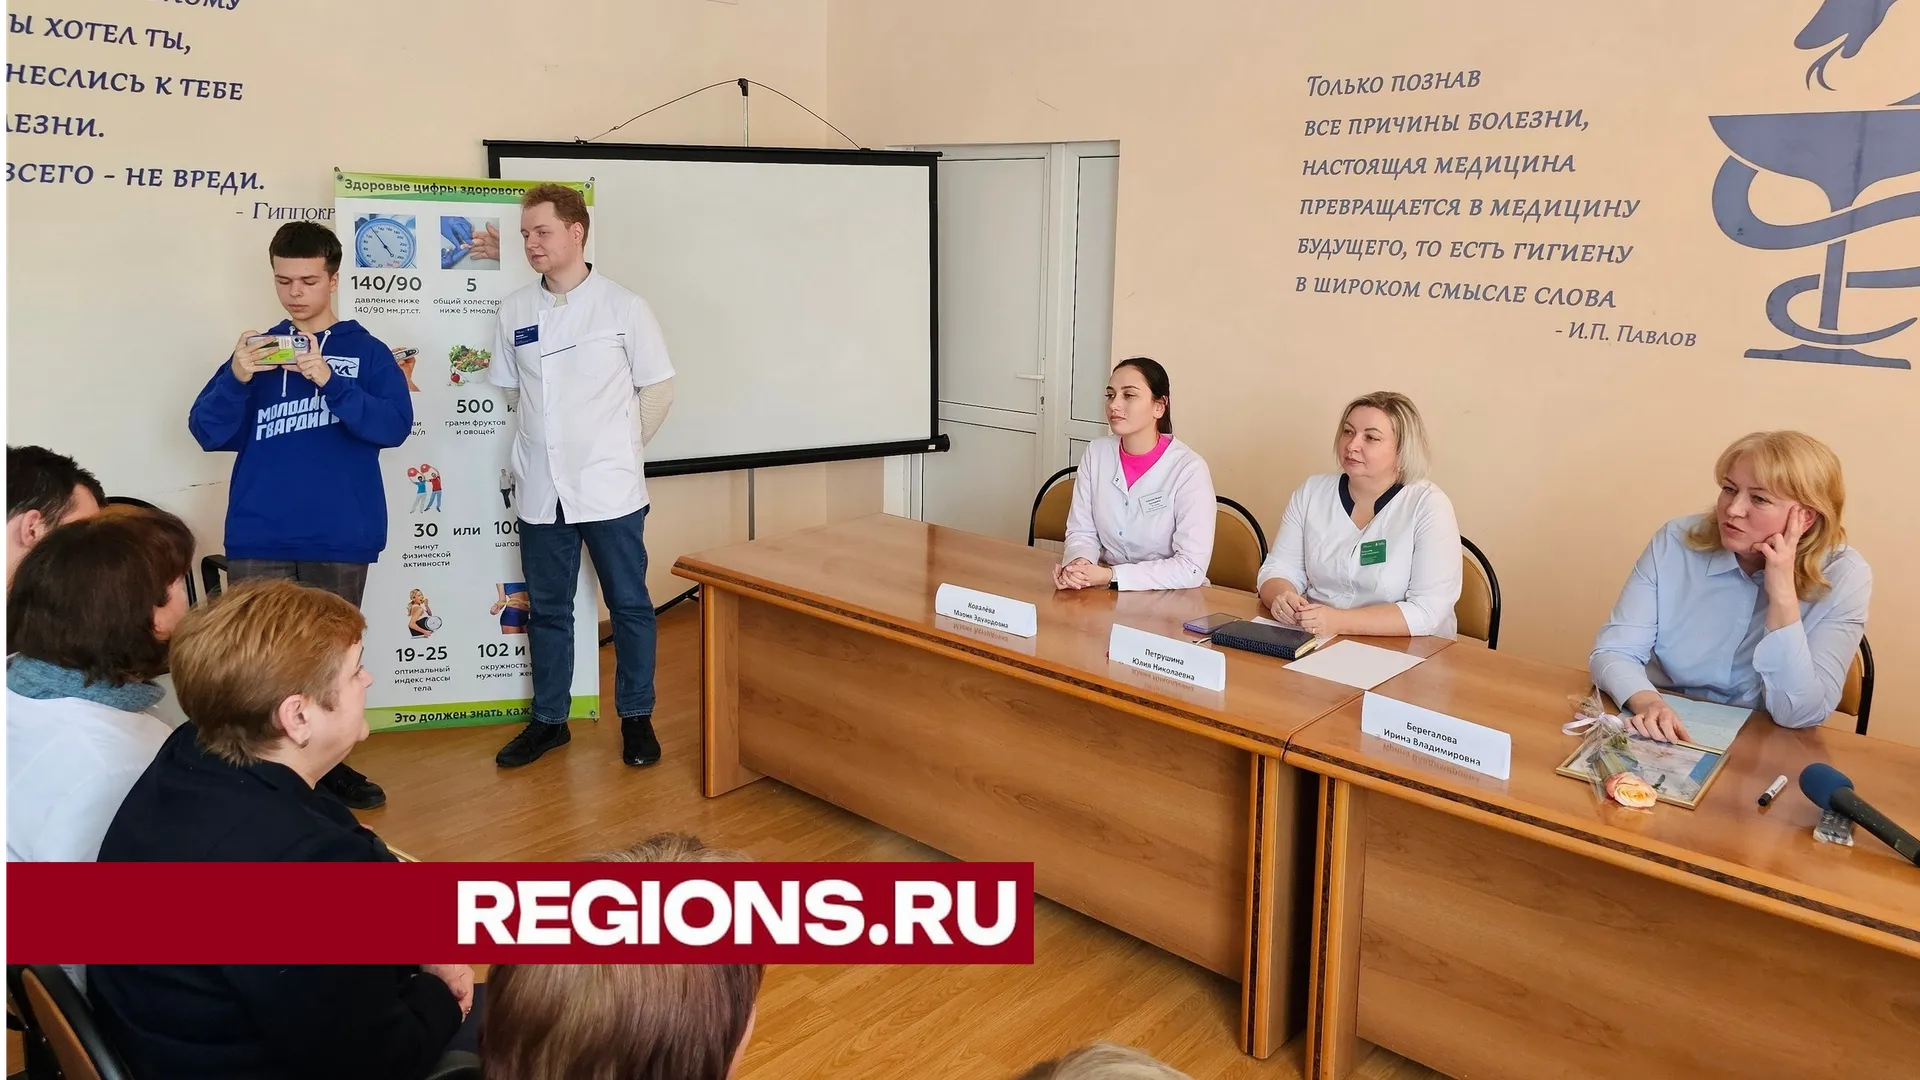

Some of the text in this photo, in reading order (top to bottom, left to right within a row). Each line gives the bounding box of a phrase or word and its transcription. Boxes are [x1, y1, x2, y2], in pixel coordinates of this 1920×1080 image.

[44, 17, 137, 45] ХОТЕЛ
[146, 29, 191, 55] ТЫ,
[155, 76, 172, 95] К
[180, 78, 243, 101] ТЕБЕ
[1304, 109, 1589, 136] ВСЕ ПРИЧИНЫ БОЛЕЗНИ,
[1302, 154, 1576, 180] НАСТОЯЩАЯ МЕДИЦИНА
[126, 168, 163, 187] НЕ
[173, 169, 265, 195] ВРЕДИ.
[345, 178, 526, 197] Здоровые цифры здорового
[1299, 198, 1641, 223] ПРЕВРАЩАЕТСЯ В МЕДИЦИНУ
[1297, 238, 1634, 264] БУДУЩЕГО, ТО ЕСТЬ ГИГИЕНУ
[351, 275, 422, 293] 140/90
[466, 278, 477, 292] 5
[1295, 276, 1617, 309] В ШИРОКОМ СМЫСЛЕ СЛОВА
[354, 306, 384, 314] 140/90
[433, 298, 460, 306] общий
[1568, 322, 1609, 342] И.П.
[456, 399, 494, 413] 500
[473, 419, 506, 427] фруктов
[414, 523, 438, 538] 30
[453, 527, 481, 535] или
[402, 551, 451, 560] физической
[395, 646, 448, 662] 19-25
[477, 642, 526, 658] 102 и
[1145, 648, 1185, 666] Петрушина
[394, 665, 451, 675] оптимальный
[476, 672, 513, 680] мужчины
[480, 663, 528, 671] окружность
[1132, 657, 1195, 681] Юлия Николаевна
[394, 713, 417, 723] Это
[419, 711, 467, 723] должен
[469, 709, 503, 719] знать
[1406, 721, 1458, 745] Берегалова
[1383, 728, 1481, 767] Ирина Владимировна
